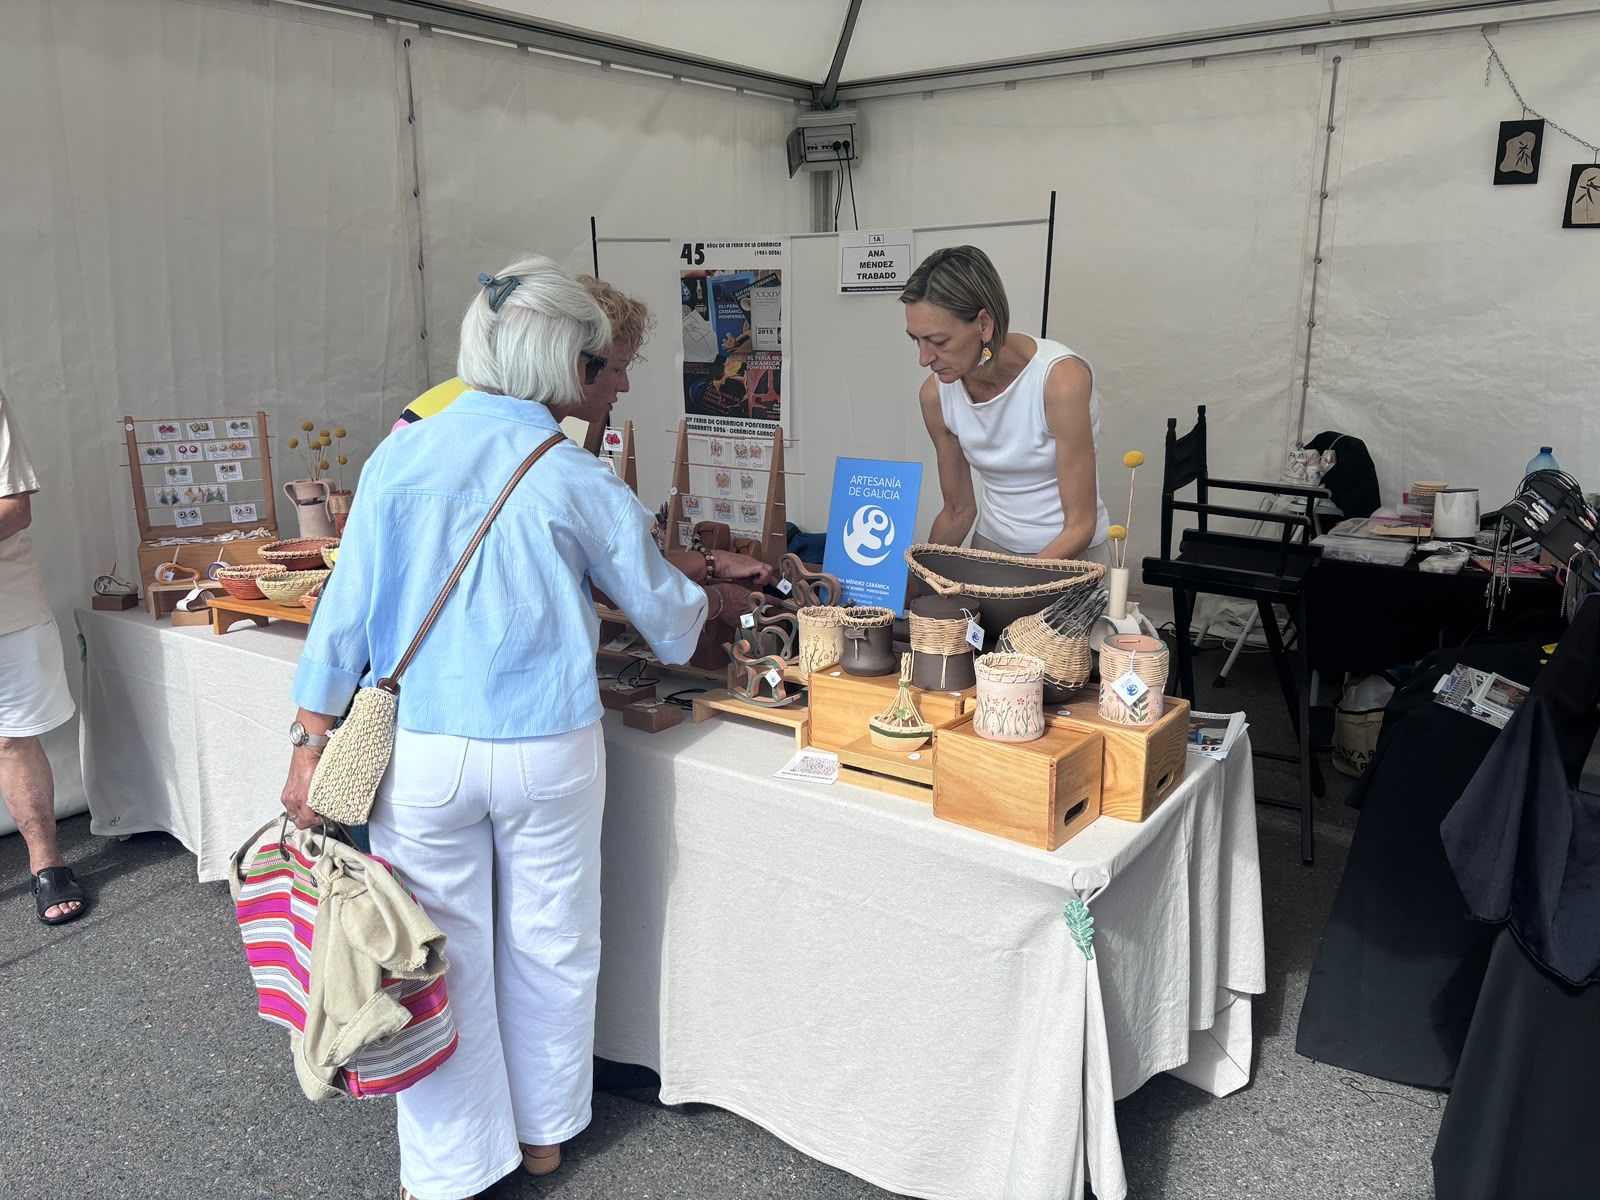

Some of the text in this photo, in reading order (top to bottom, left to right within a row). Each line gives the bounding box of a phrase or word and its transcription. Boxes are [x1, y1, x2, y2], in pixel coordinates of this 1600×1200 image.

[680, 243, 705, 265] 45
[868, 250, 886, 258] ANA
[860, 260, 894, 268] MÉNDEZ
[856, 272, 896, 280] TRABADO
[850, 475, 902, 488] ARTESANÍA
[848, 487, 900, 500] DE GALICIA
[846, 579, 865, 587] MÉNDEZ
[865, 582, 890, 590] CERÁMICA
